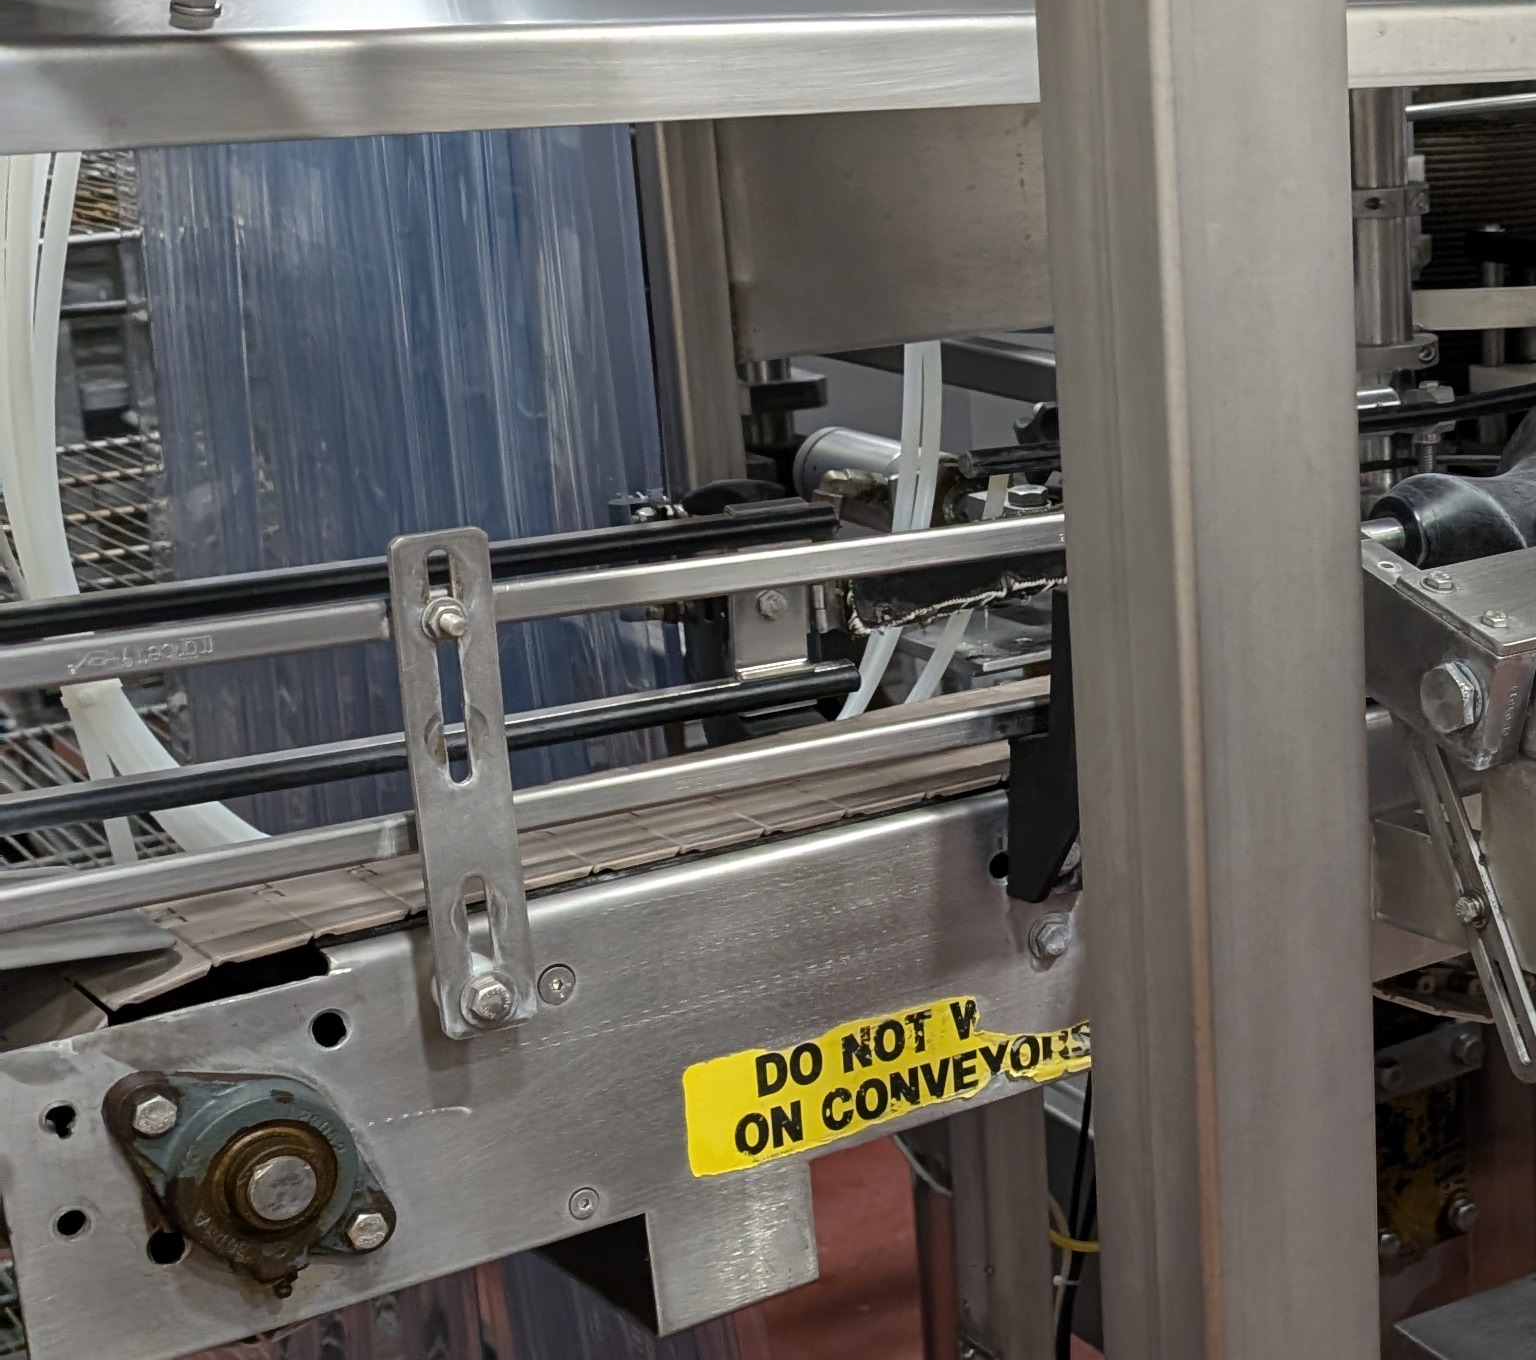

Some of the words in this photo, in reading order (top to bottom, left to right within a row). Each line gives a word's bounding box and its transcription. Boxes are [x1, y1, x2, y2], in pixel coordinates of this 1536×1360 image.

[755, 1042, 823, 1098] DO
[841, 1009, 932, 1073] NOT
[734, 1100, 804, 1156] ON
